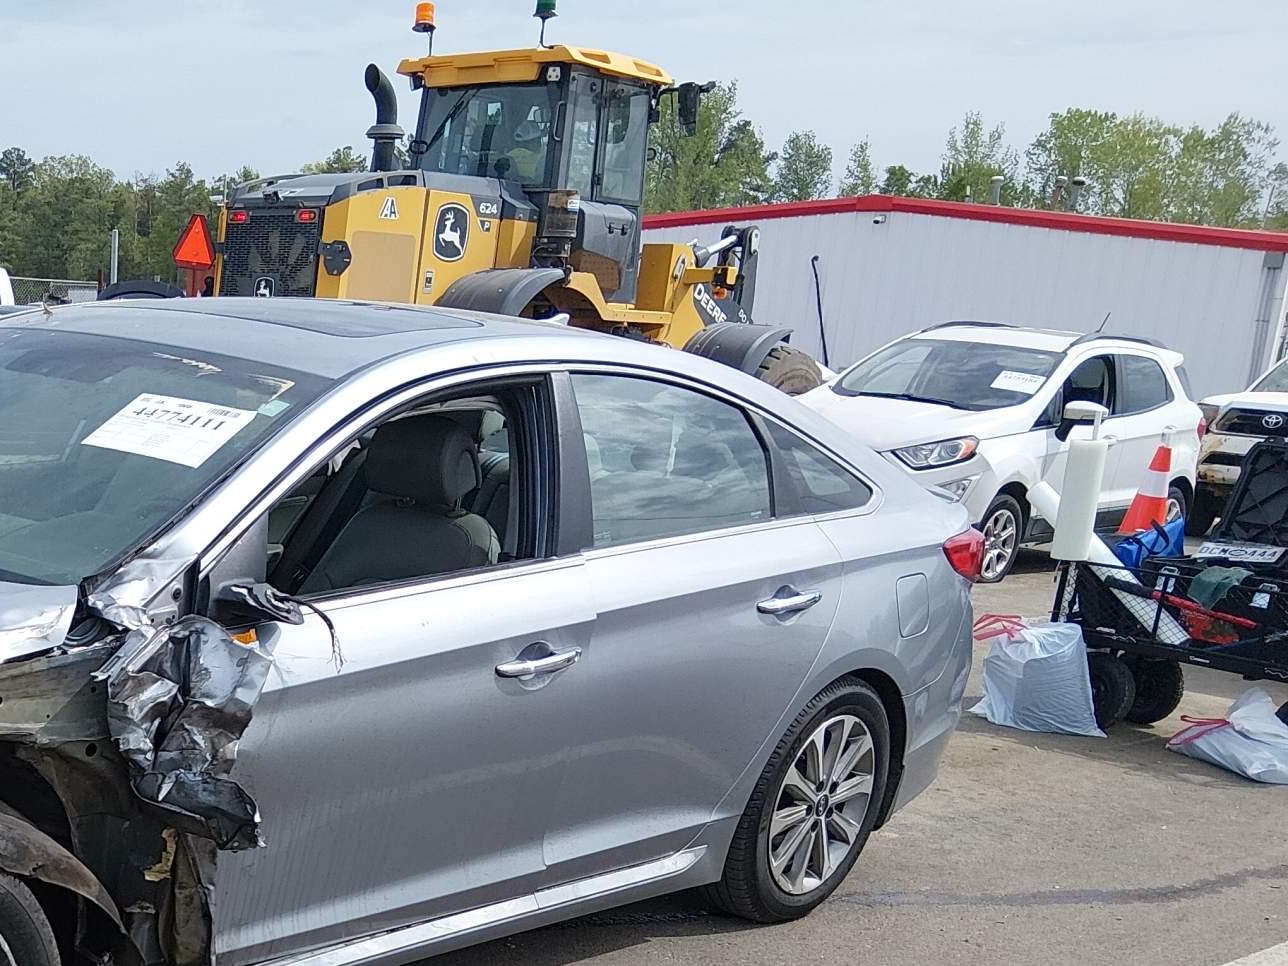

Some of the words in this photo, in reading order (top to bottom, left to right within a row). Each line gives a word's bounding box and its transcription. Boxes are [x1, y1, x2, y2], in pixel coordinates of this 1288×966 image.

[479, 203, 497, 214] 624
[483, 222, 490, 231] P
[694, 283, 727, 323] DEERE
[133, 407, 226, 430] 44774111
